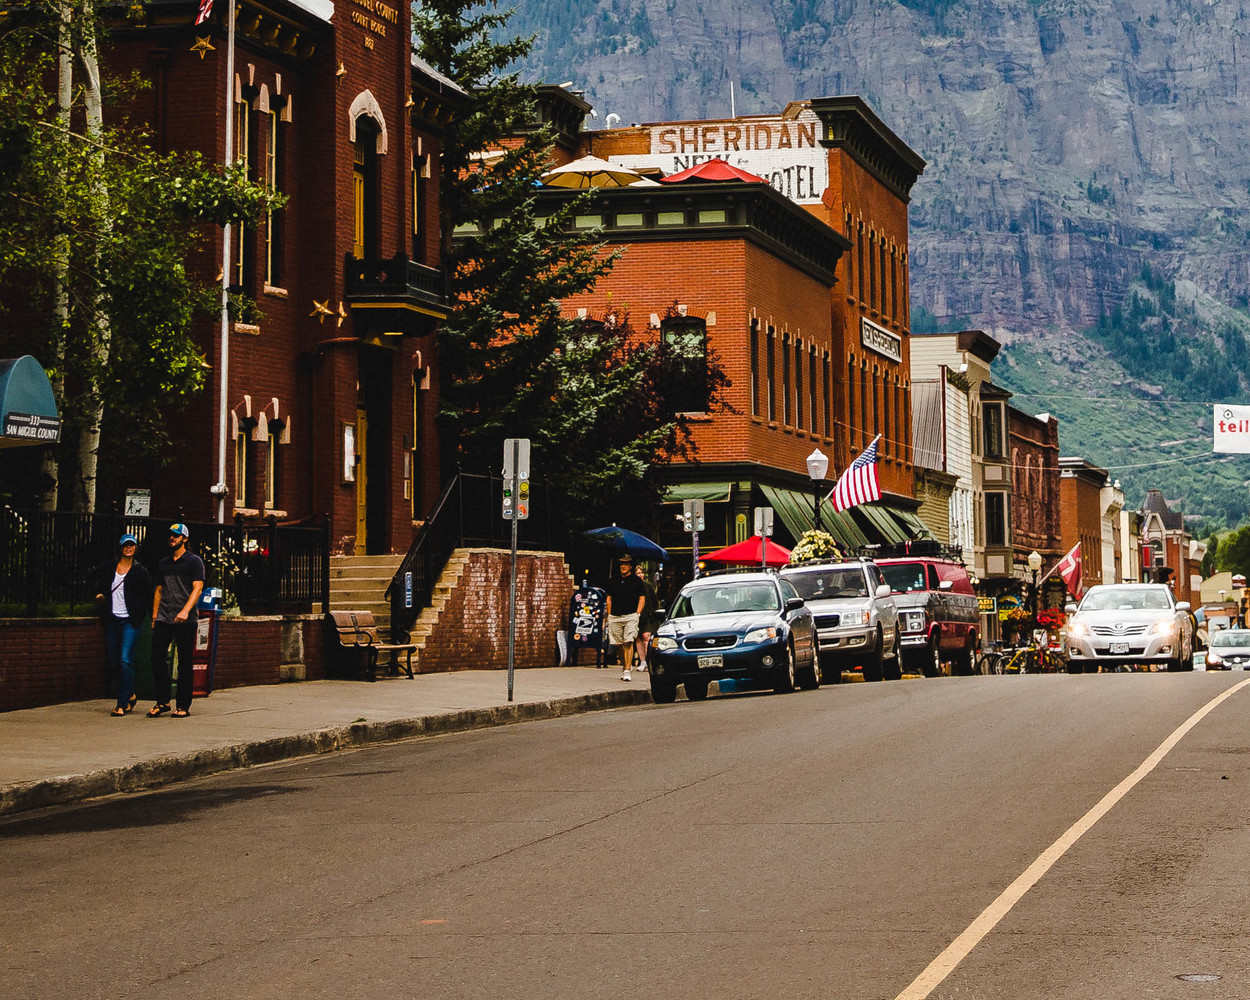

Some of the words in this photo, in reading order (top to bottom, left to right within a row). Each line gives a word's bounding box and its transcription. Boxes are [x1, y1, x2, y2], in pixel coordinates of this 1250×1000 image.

[375, 1, 399, 25] COUNTY
[659, 122, 816, 154] SHERIDAN
[30, 415, 40, 426] 333
[6, 424, 18, 435] SAN
[17, 425, 37, 437] MIGUEL
[37, 427, 58, 440] COUNTY
